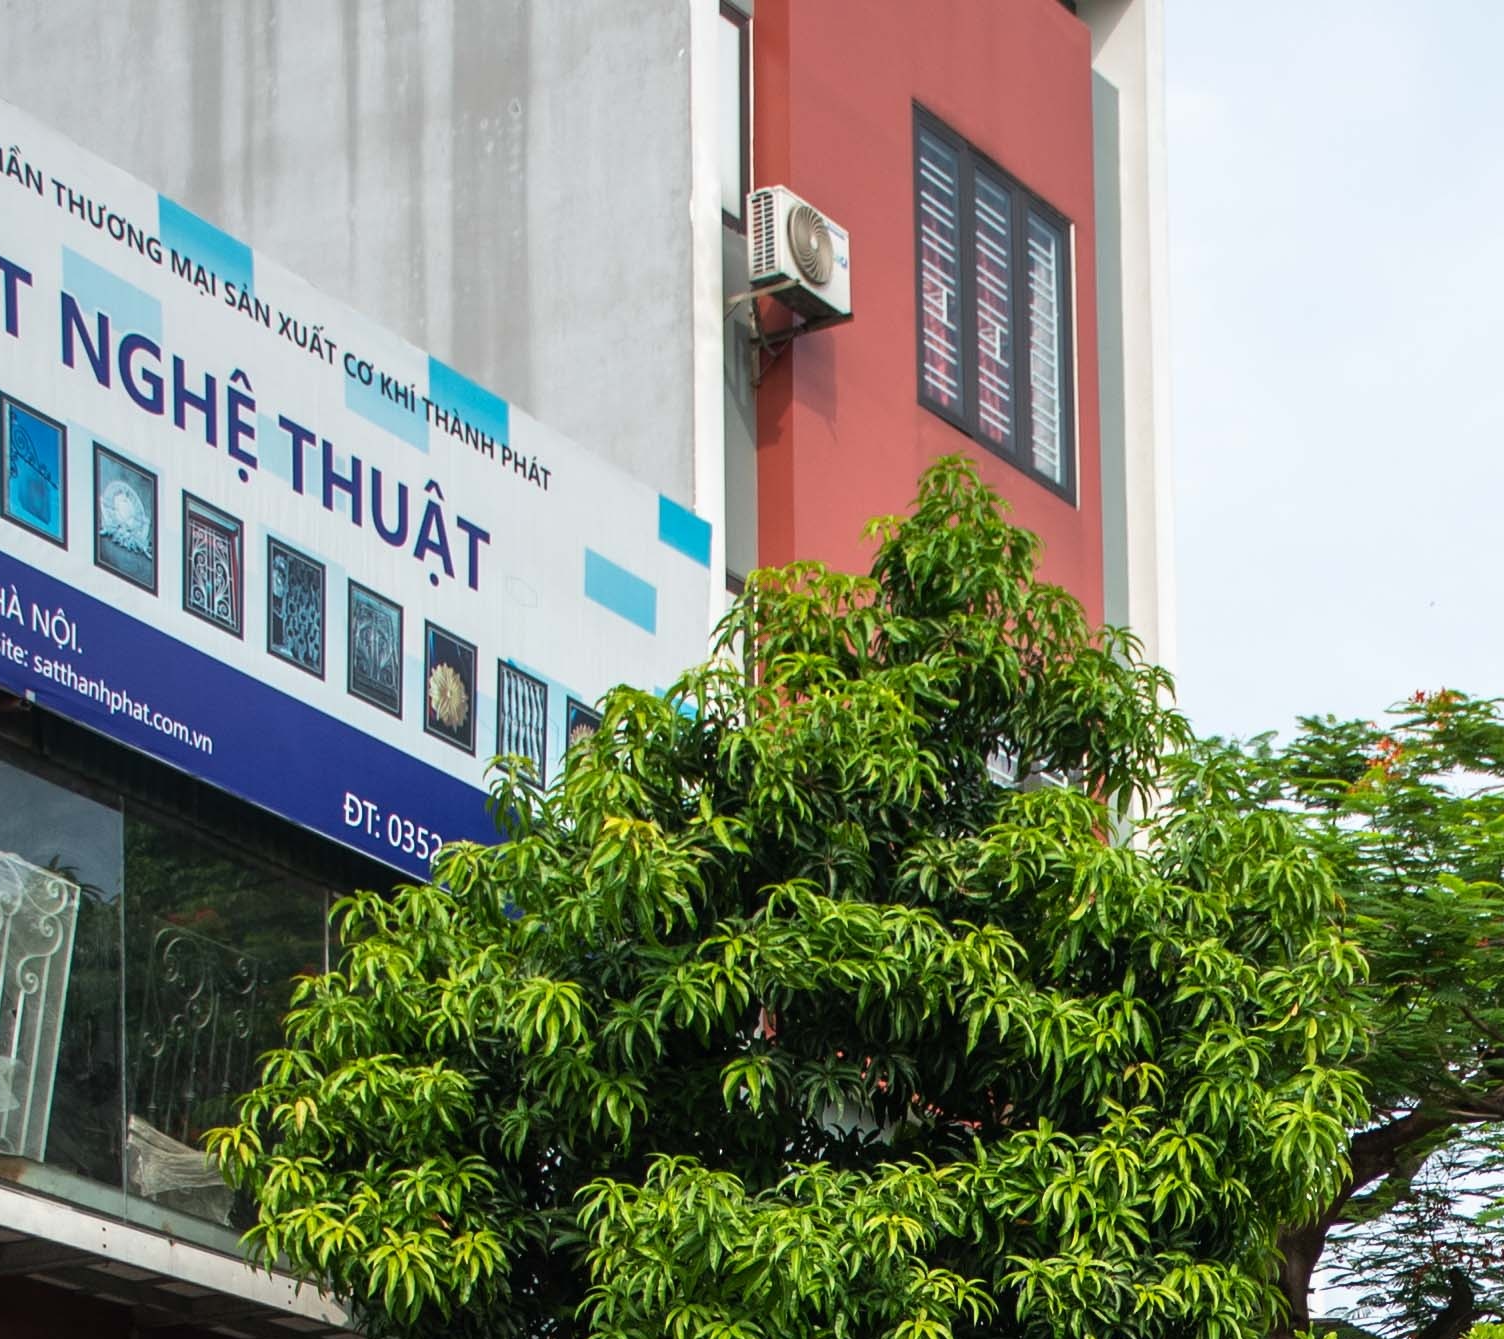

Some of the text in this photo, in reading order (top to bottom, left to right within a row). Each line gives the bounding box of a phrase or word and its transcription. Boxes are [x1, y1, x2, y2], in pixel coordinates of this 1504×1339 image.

[51, 177, 164, 265] THƯƠNG
[170, 248, 217, 298] MẠI
[224, 280, 271, 329] SẢN
[278, 311, 337, 366] XUẤT
[343, 351, 375, 387] CƠ
[380, 371, 416, 413] KHÍ
[421, 395, 495, 459] THÀNH
[501, 445, 553, 492] PHÁT
[60, 289, 258, 484] NGHỆ
[278, 413, 491, 592] THUẬT
[32, 602, 84, 655] NỘI.
[33, 655, 214, 756] satthanhphat.com.vn
[343, 791, 381, 839] ĐT:
